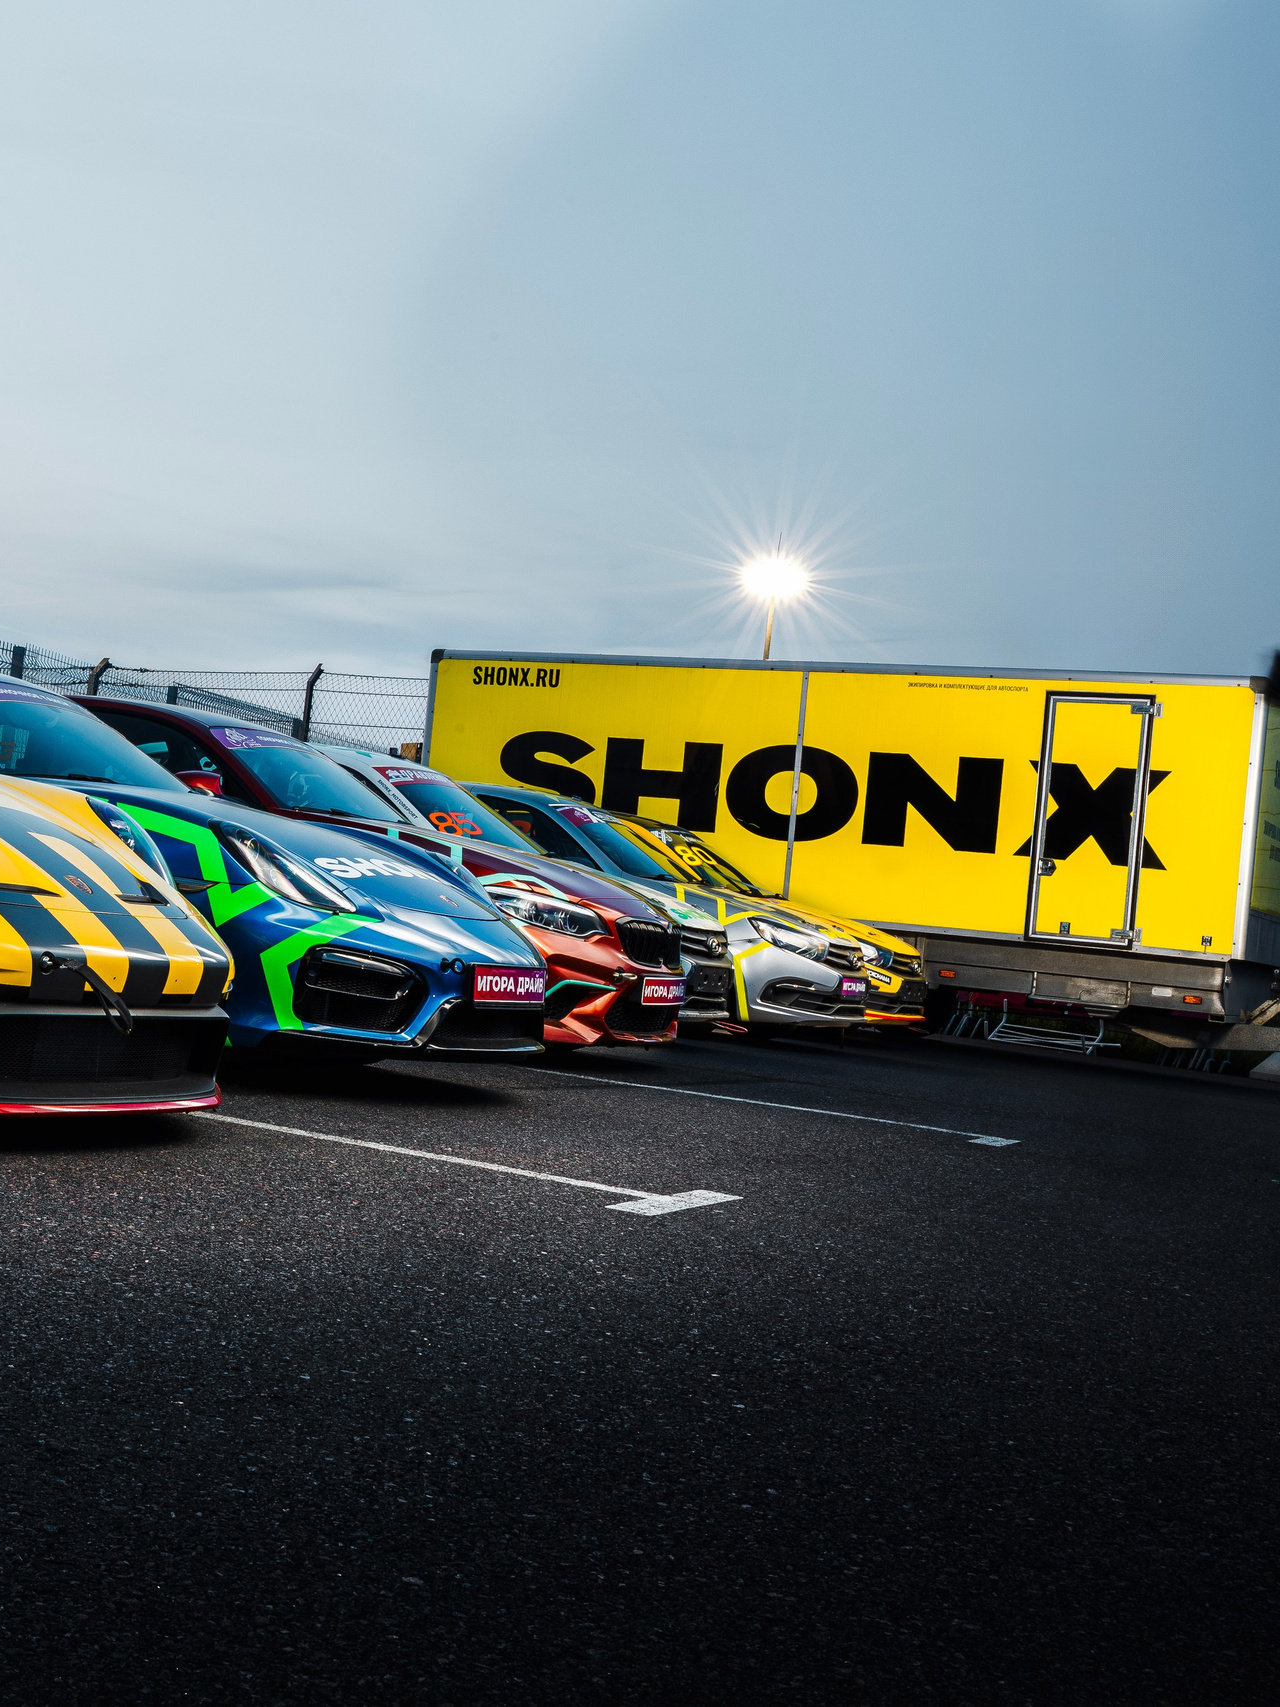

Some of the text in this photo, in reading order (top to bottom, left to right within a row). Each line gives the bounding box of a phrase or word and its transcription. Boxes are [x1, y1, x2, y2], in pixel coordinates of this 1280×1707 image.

[472, 664, 561, 689] SHONX.RU
[500, 730, 1172, 871] SHONX
[428, 811, 483, 837] 85
[674, 845, 718, 867] 80
[477, 973, 544, 996] ИГОРА ДРАЙВ
[644, 985, 668, 998] ИГОРА
